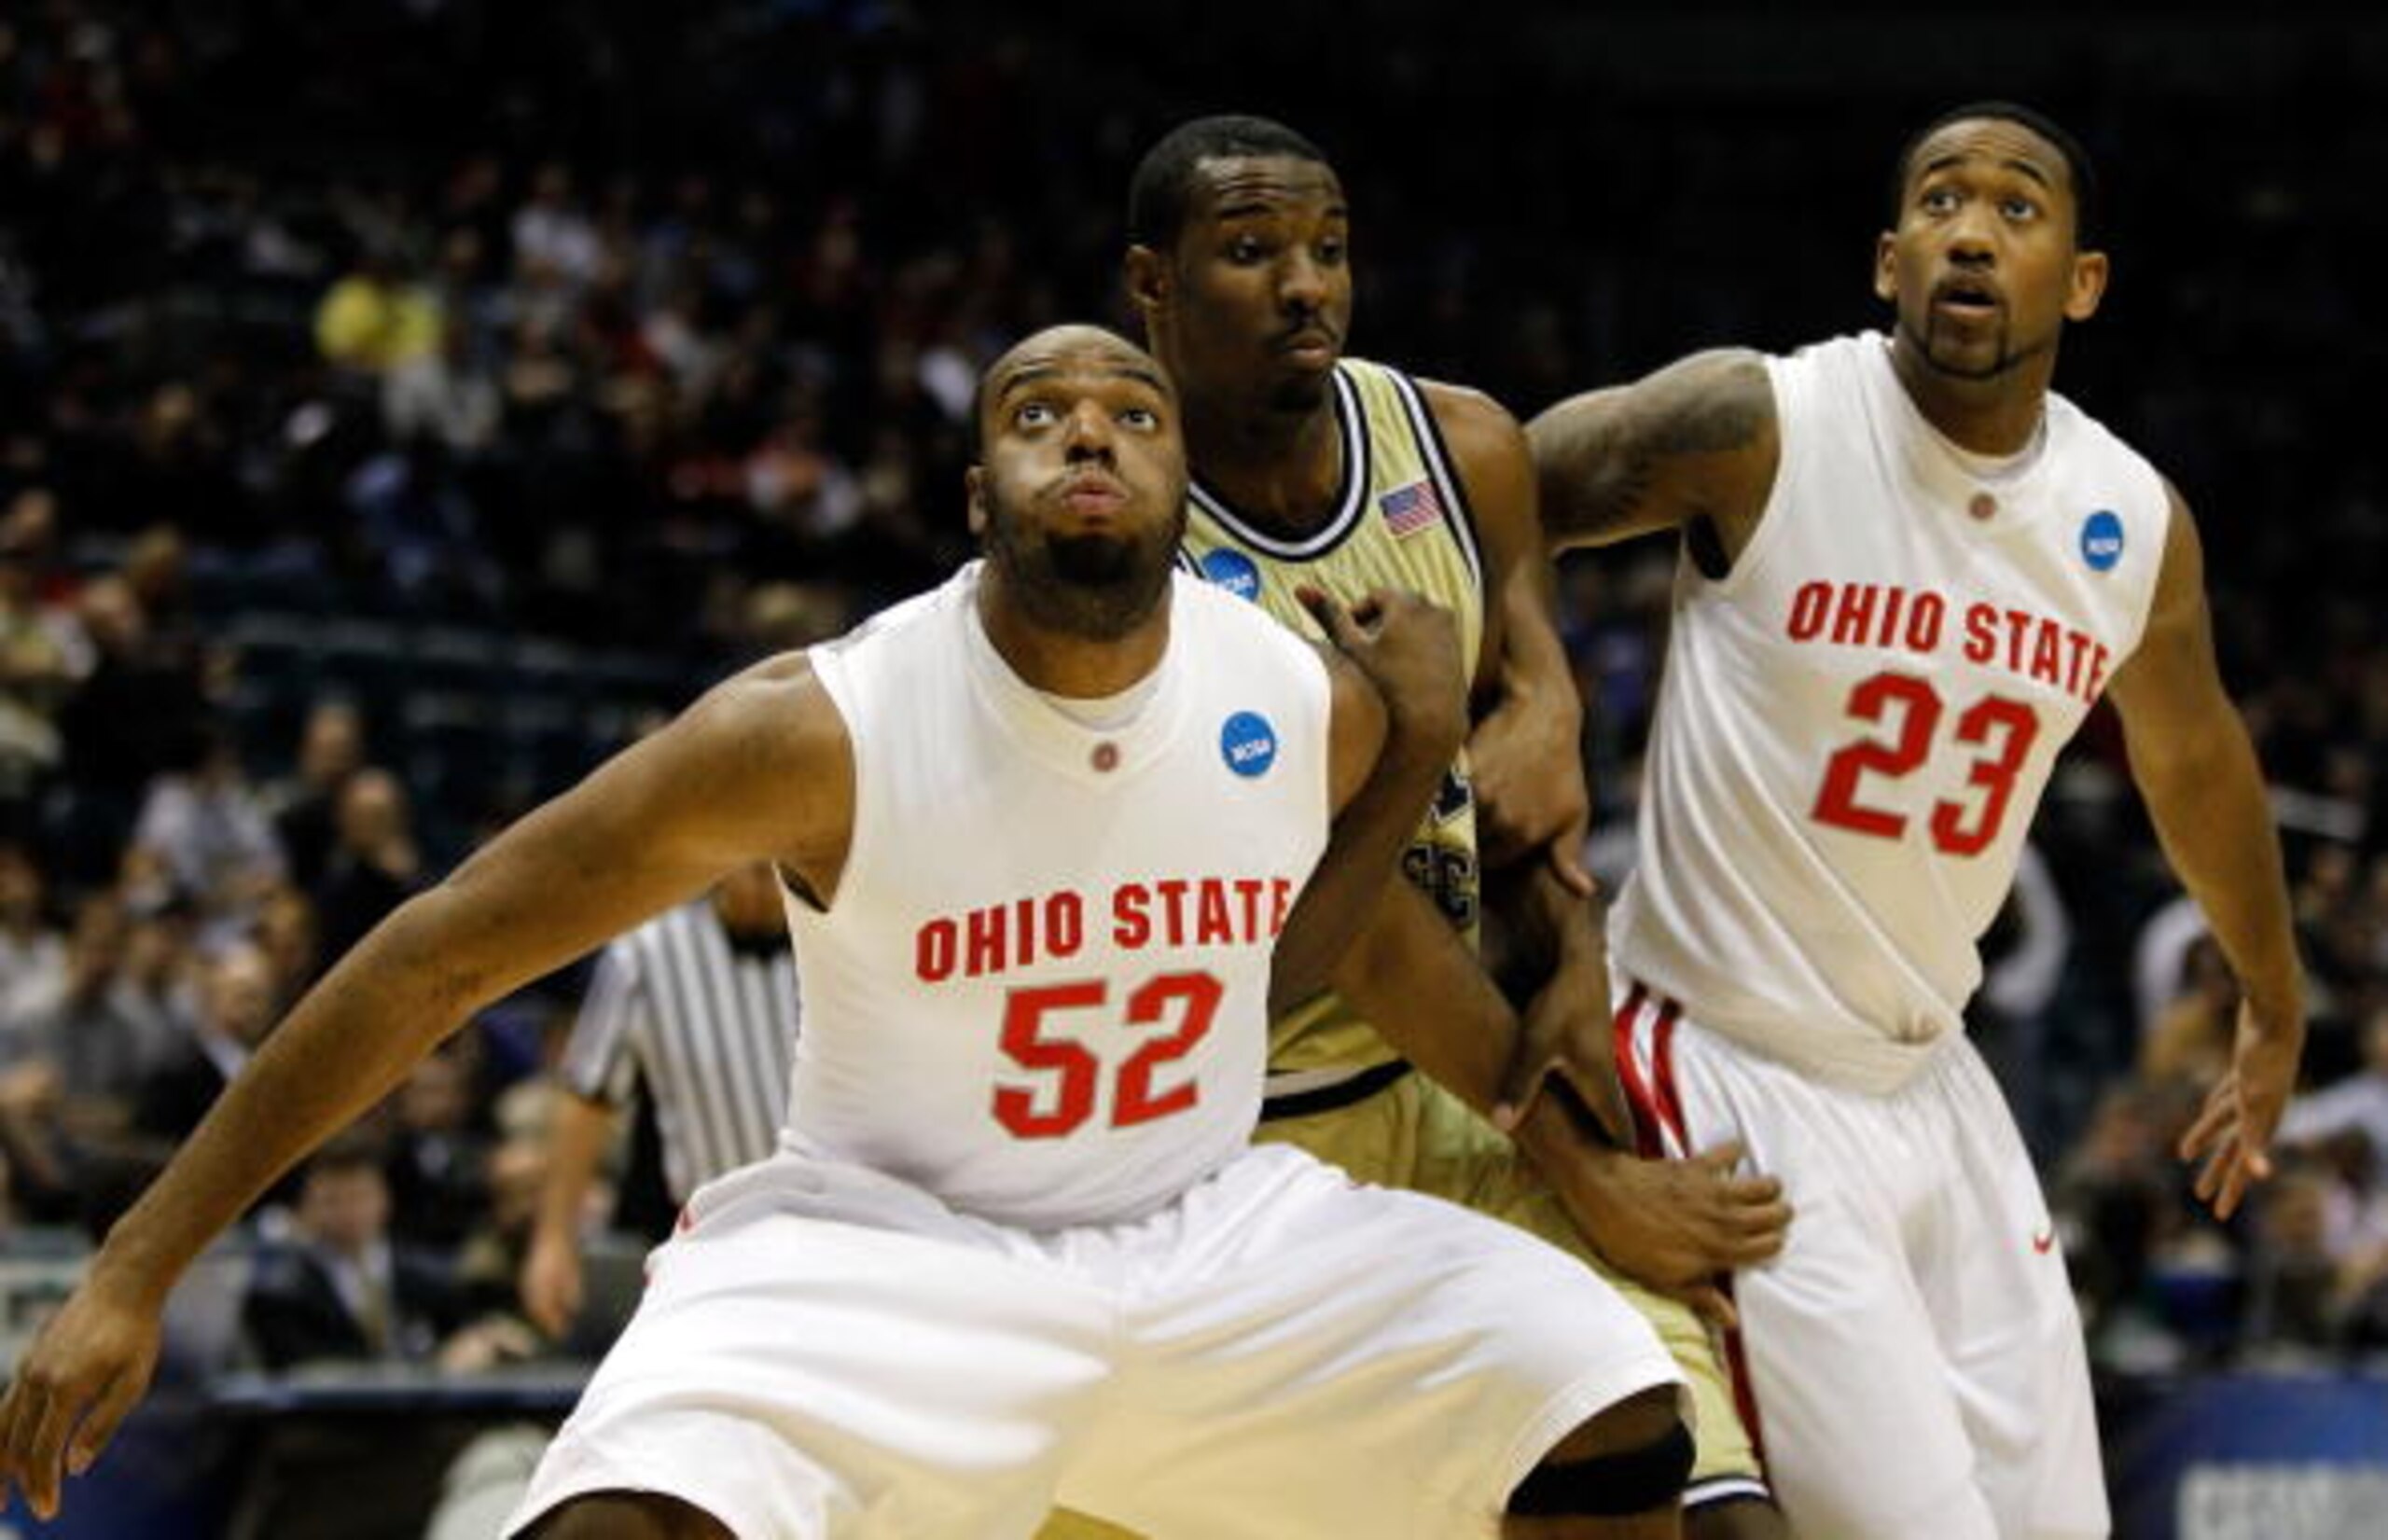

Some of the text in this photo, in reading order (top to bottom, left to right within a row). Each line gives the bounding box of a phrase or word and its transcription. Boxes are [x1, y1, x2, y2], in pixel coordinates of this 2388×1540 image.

[1786, 581, 2110, 706] OHIO STATE
[1811, 671, 2040, 856] 23
[916, 877, 1291, 982] OHIO STATE
[992, 970, 1224, 1139] 52
